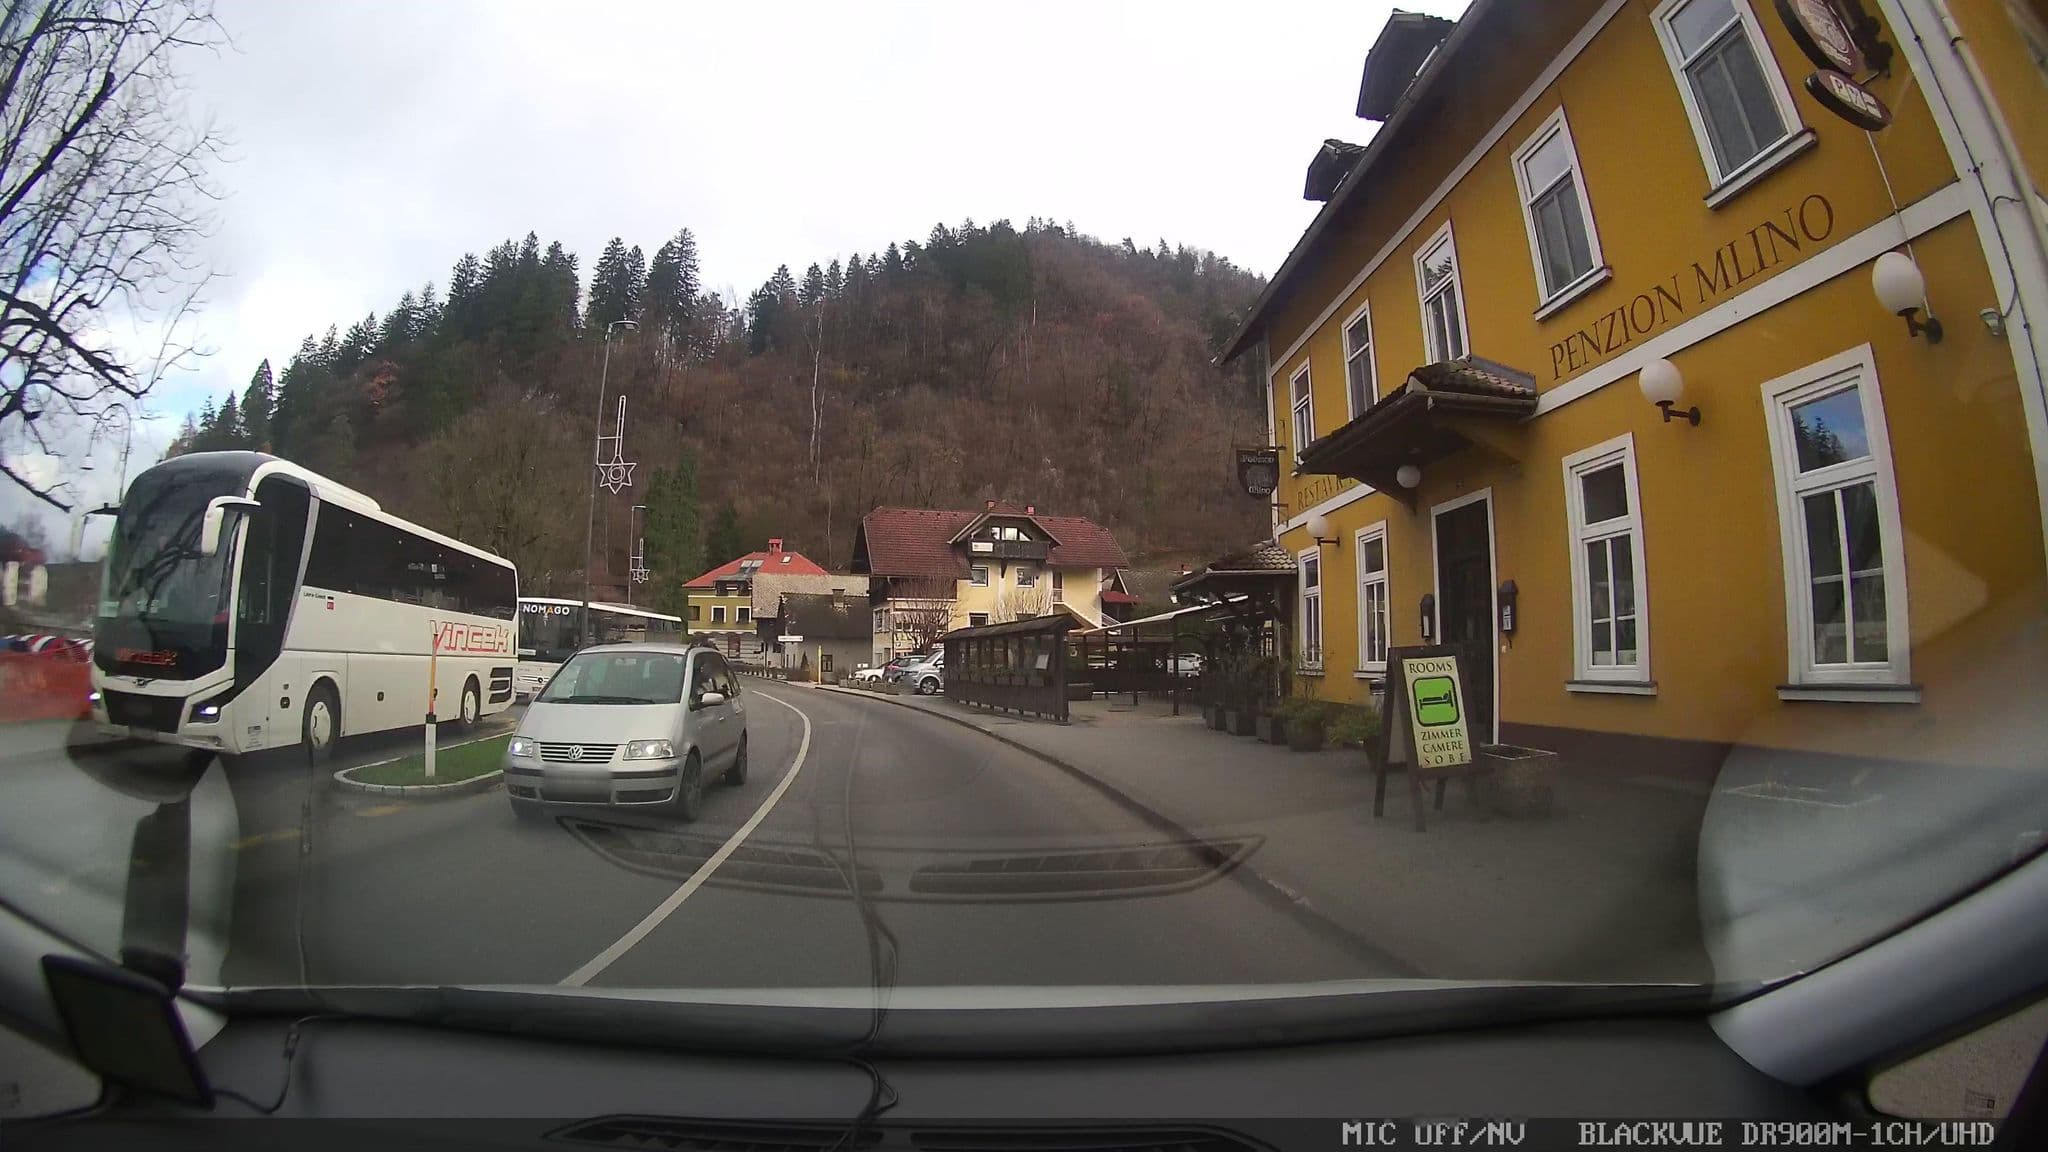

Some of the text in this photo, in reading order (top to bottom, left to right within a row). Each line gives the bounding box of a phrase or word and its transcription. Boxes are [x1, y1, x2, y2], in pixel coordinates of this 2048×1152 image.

[1549, 194, 1835, 381] PENZION MLINO
[522, 604, 570, 616] NOMAGO
[1409, 661, 1453, 674] ROOMS
[1420, 728, 1463, 741] ZIMMER
[1422, 740, 1464, 754] CAMERE
